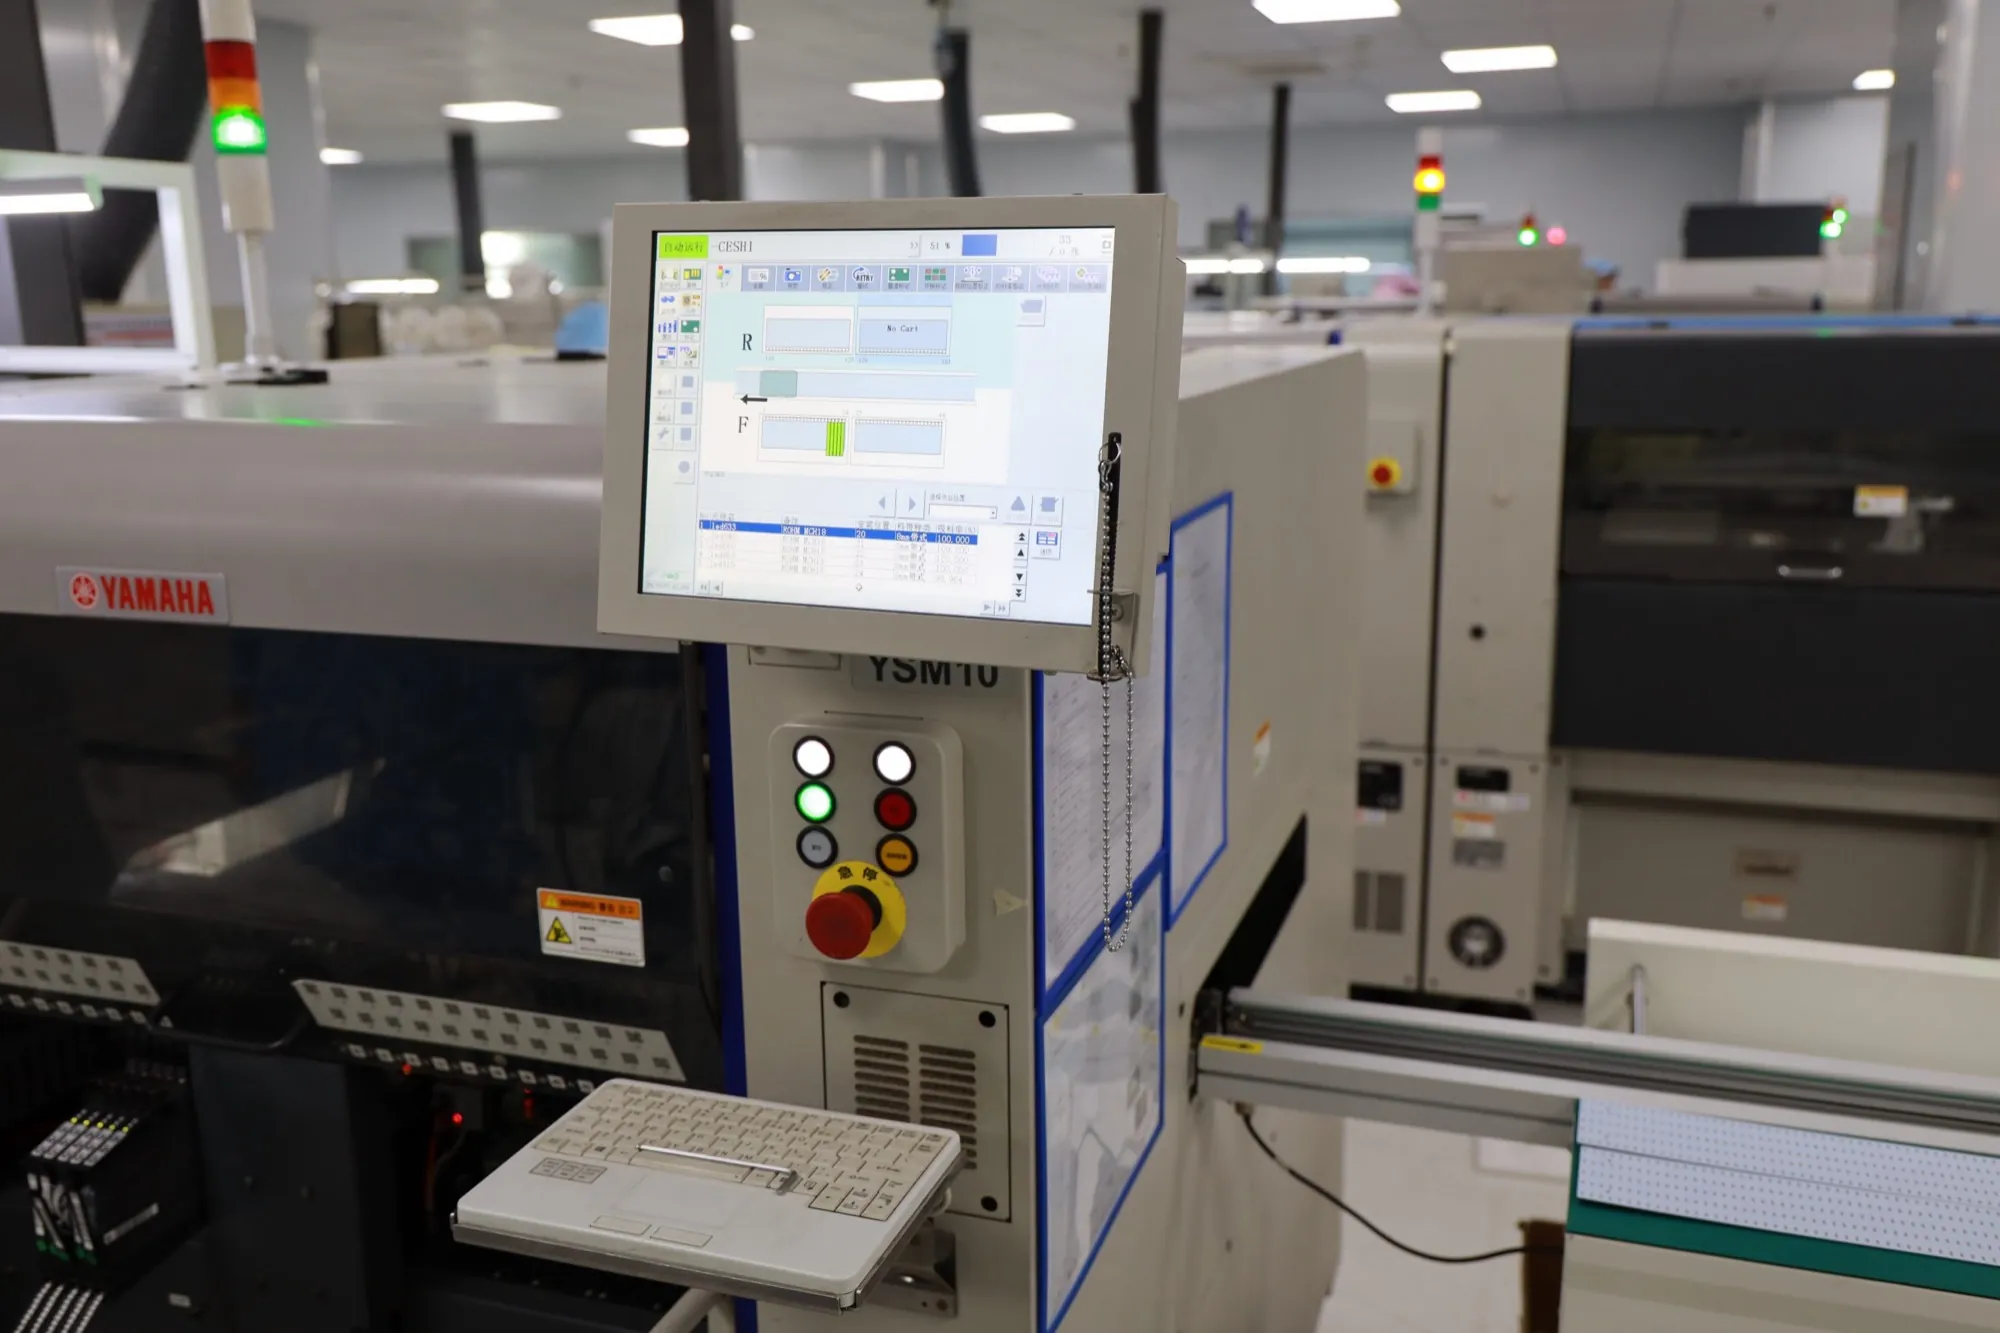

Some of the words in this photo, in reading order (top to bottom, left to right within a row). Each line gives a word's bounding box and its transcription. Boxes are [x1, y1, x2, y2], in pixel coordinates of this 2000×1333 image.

[664, 241, 704, 253] 自动运行
[886, 324, 896, 333] No
[900, 324, 919, 333] Cart
[742, 333, 753, 351] R
[738, 416, 749, 434] F
[783, 526, 801, 535] ROHM
[856, 530, 866, 539] 20
[100, 575, 215, 616] YAMAHA
[869, 656, 998, 688] YSM10
[837, 866, 878, 881] 急停
